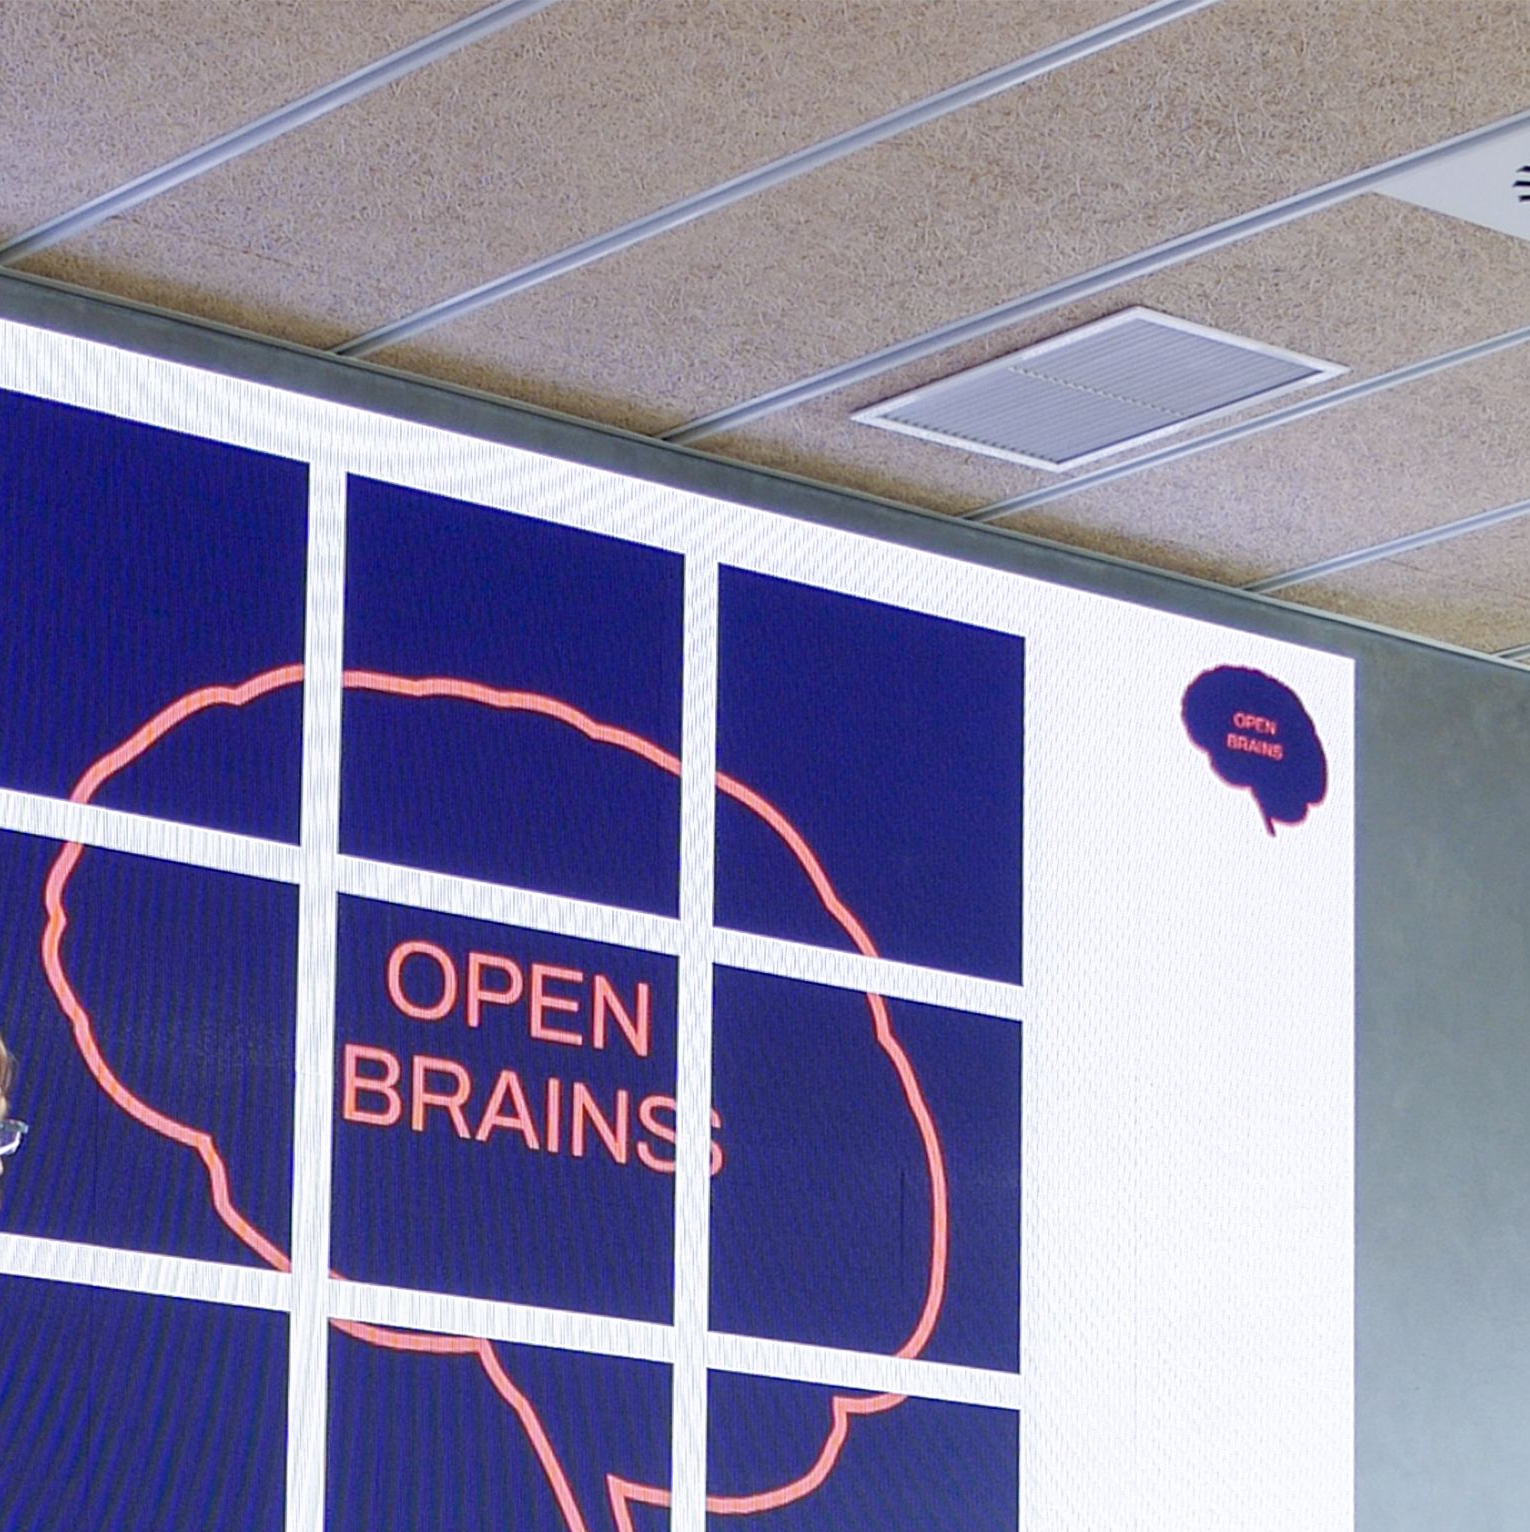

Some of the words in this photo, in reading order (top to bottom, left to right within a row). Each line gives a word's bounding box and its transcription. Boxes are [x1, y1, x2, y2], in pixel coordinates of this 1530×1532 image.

[1226, 733, 1283, 761] BRAINS
[1232, 711, 1277, 735] OPEN
[386, 940, 651, 1058] OPEN
[341, 1042, 726, 1178] BRAINS
